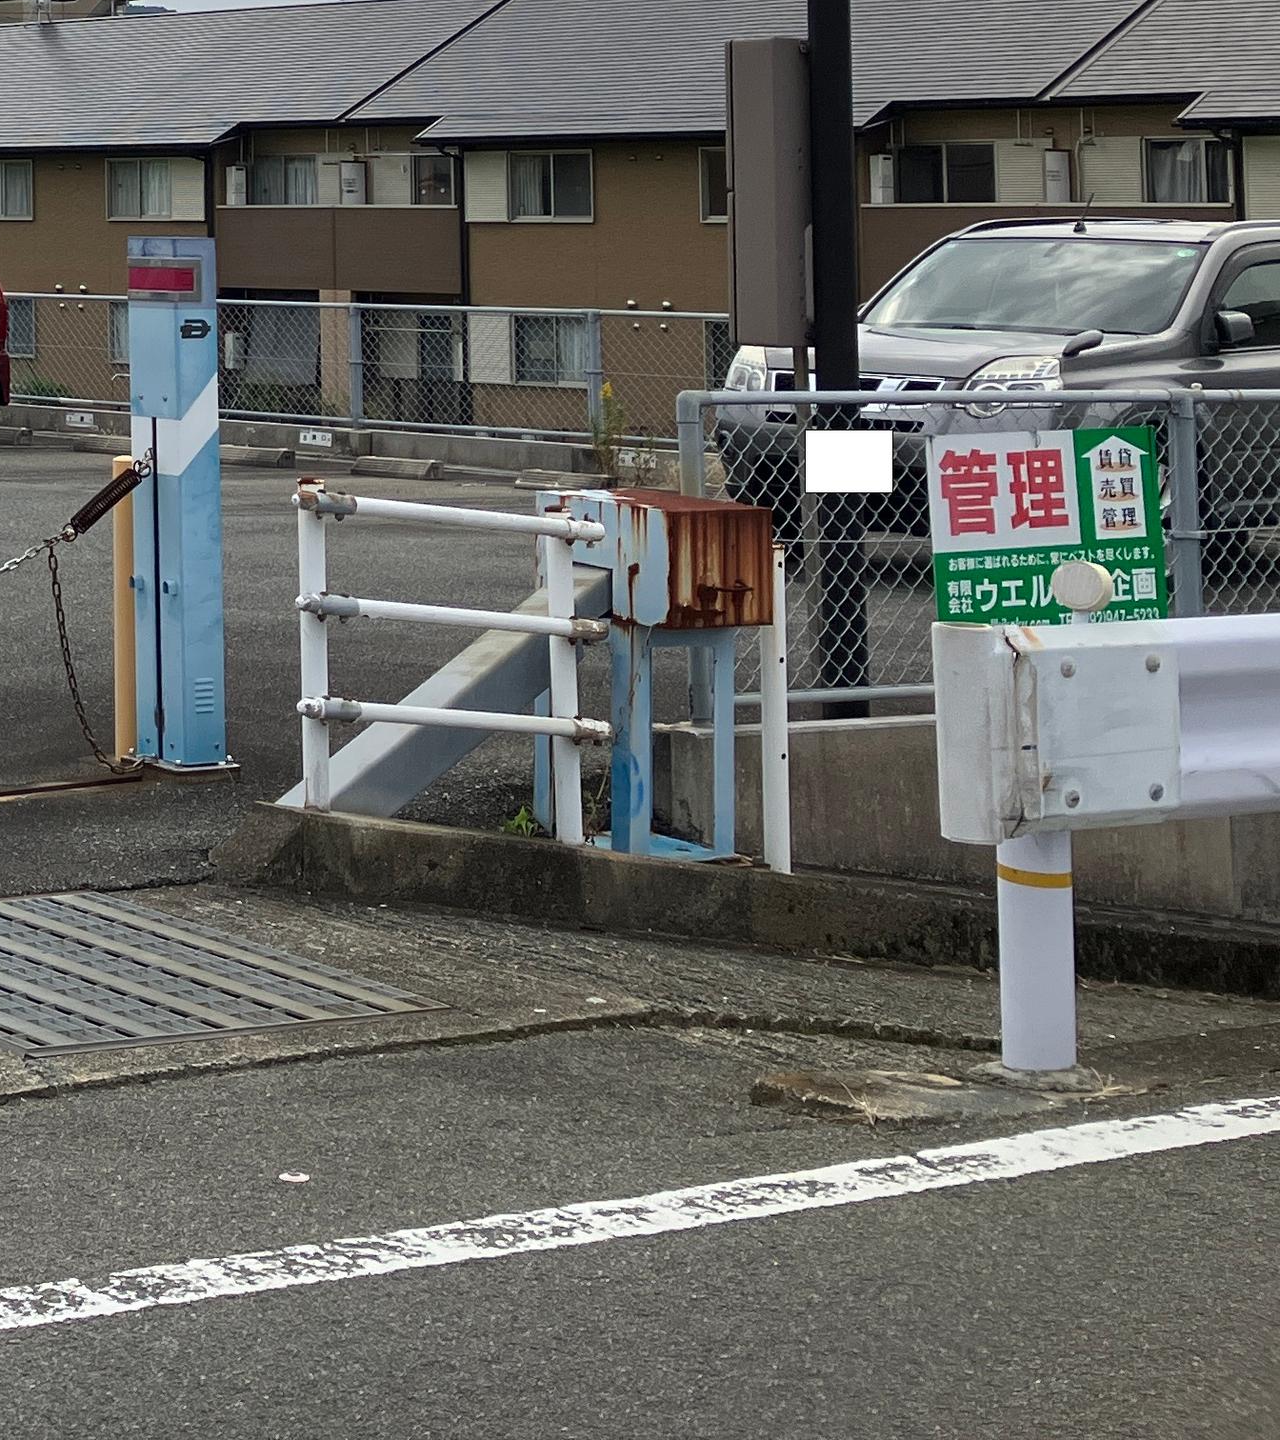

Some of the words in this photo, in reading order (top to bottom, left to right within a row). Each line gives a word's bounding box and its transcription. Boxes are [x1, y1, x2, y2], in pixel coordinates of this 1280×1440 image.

[1098, 447, 1133, 469] 賃貸
[938, 447, 1070, 537] 管理
[1100, 476, 1136, 499] 売買
[1102, 506, 1138, 528] 管理
